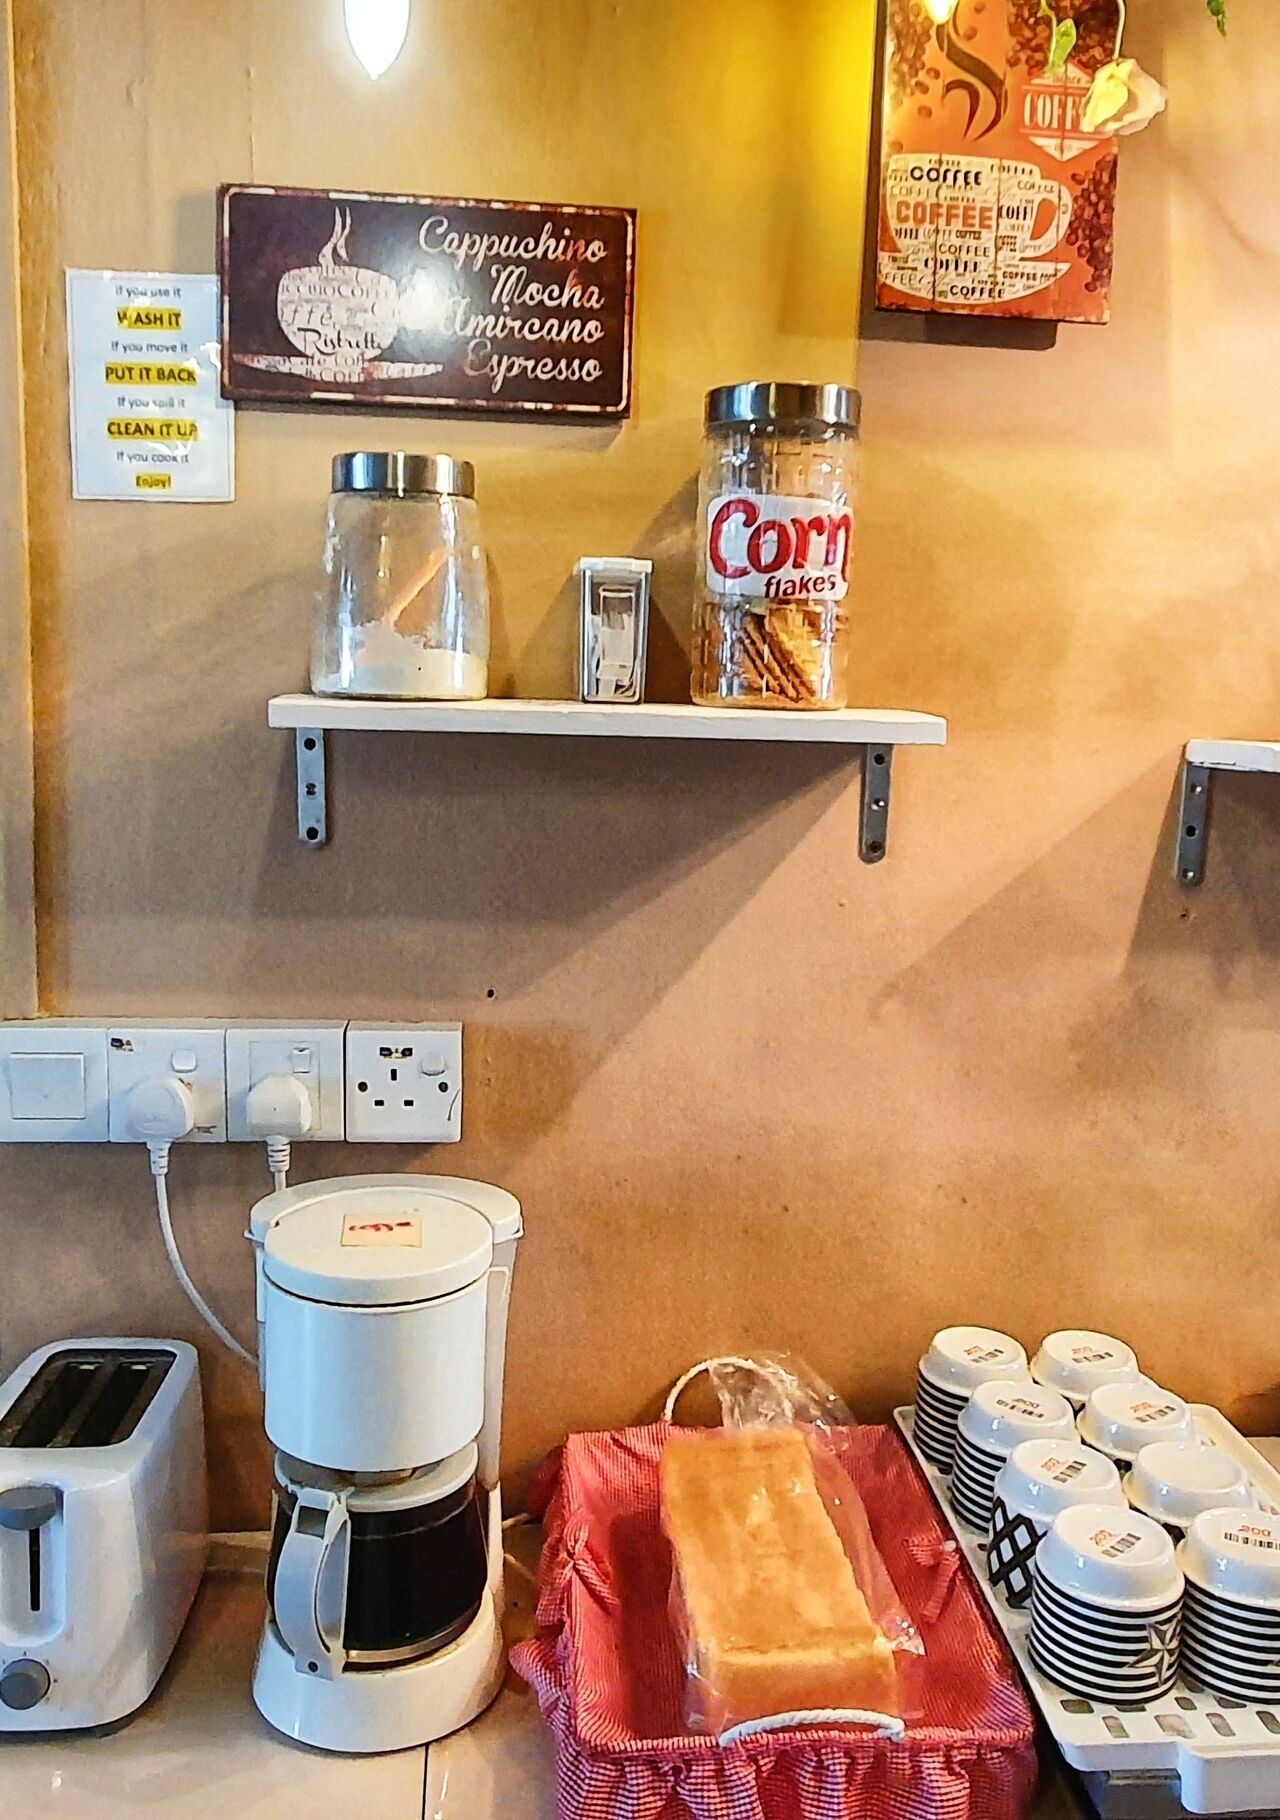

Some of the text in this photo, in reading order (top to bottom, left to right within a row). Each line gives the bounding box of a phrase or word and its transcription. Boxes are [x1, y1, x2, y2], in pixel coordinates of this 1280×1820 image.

[1024, 92, 1086, 129] COFF
[910, 166, 982, 188] COFFEE
[896, 201, 993, 230] COFFEE
[419, 215, 608, 272] Cappuchino
[939, 243, 990, 257] COFFEE
[490, 264, 605, 310] Mocha
[117, 312, 181, 327] WASH IT
[112, 341, 188, 354] If you move it
[105, 366, 196, 382] PUT IT BACK
[463, 337, 604, 394] Espresso
[117, 397, 125, 407] If
[129, 399, 150, 410] you
[107, 421, 198, 441] CLEAN IT UP
[117, 451, 124, 461] If
[127, 454, 148, 464] you
[136, 475, 171, 489] Enjoy!
[709, 499, 852, 583] Corn
[764, 574, 837, 599] flakes
